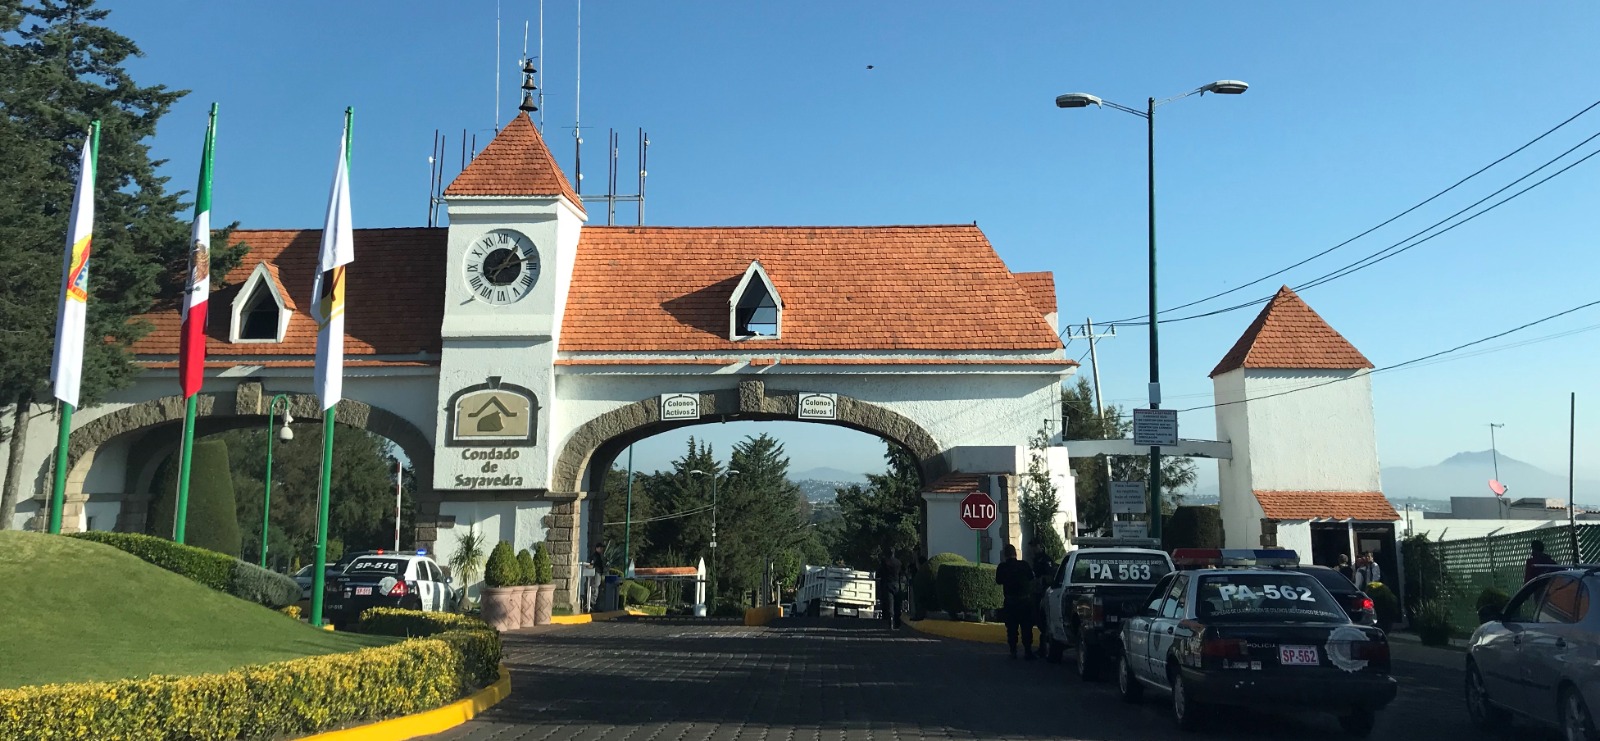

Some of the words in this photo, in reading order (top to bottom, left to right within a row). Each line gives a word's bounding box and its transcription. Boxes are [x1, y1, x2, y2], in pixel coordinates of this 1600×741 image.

[462, 447, 520, 460] Condado
[481, 461, 498, 473] de
[454, 474, 523, 489] Sayavedra
[963, 503, 994, 519] ALTO
[355, 562, 397, 570] SP-515
[1089, 563, 1113, 580] PA
[1118, 564, 1151, 580] 563
[1218, 584, 1316, 602] PA-562
[1282, 649, 1317, 663] SP-562
